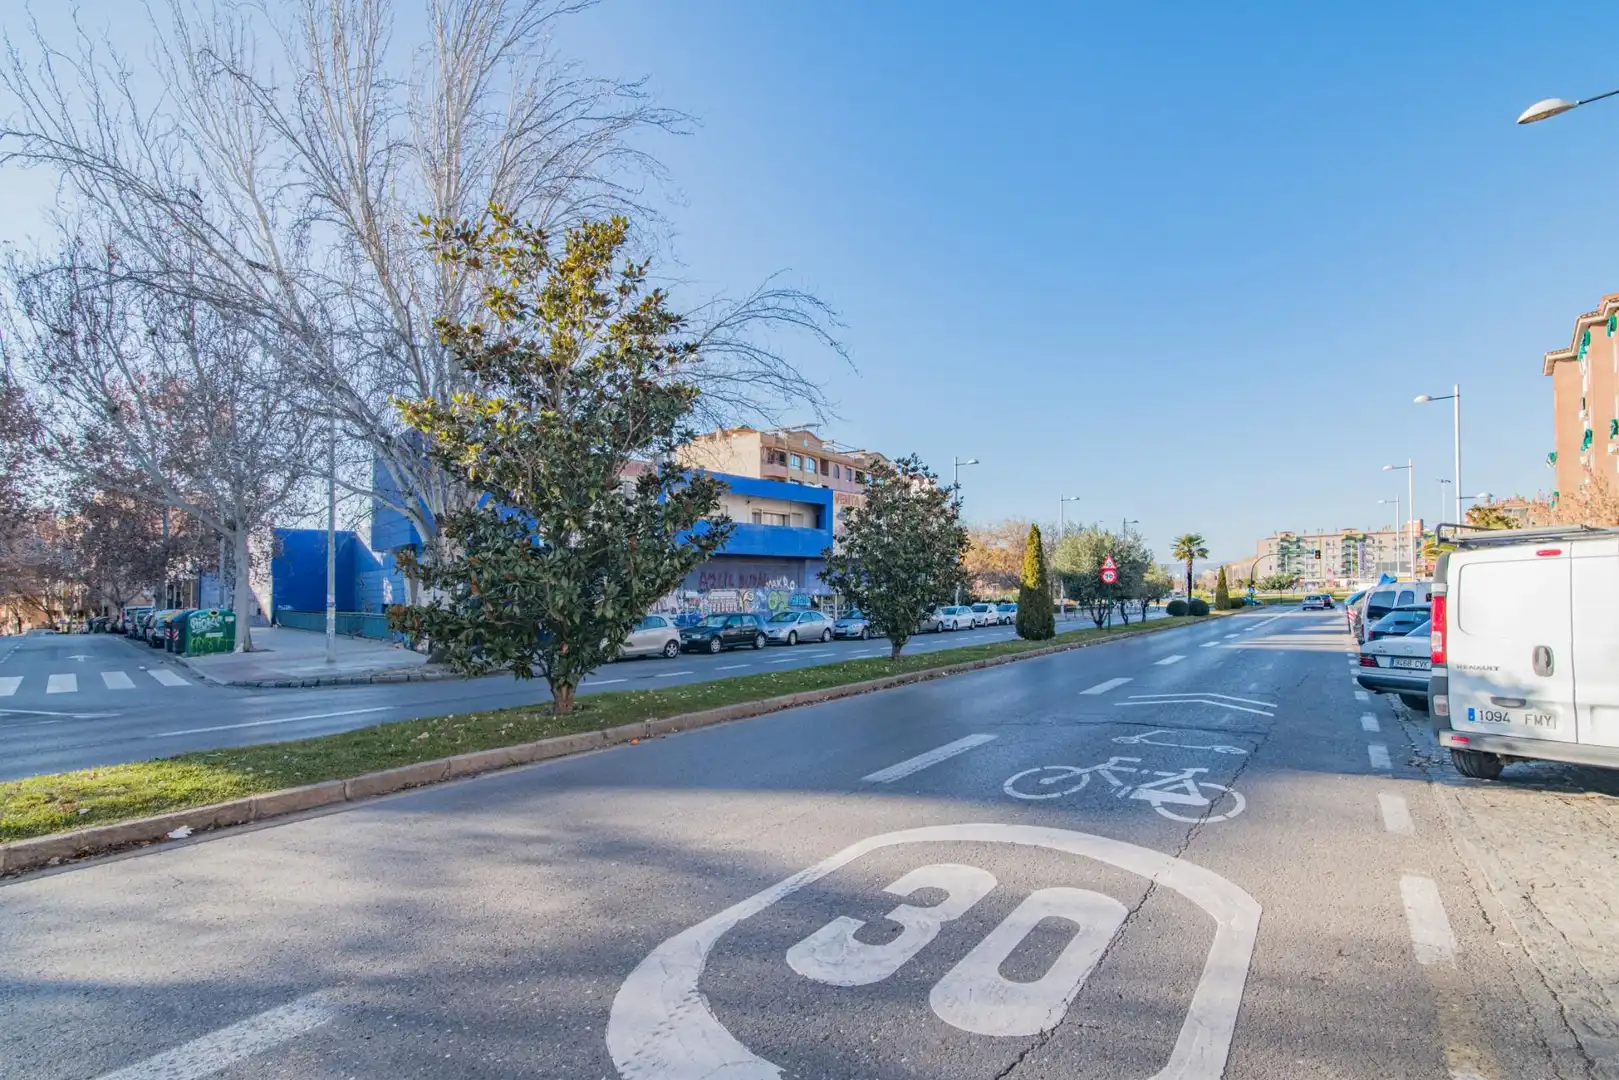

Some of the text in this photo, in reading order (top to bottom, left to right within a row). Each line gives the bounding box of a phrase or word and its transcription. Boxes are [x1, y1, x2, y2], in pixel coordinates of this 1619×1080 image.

[1478, 709, 1554, 726] 1094 FMY
[786, 863, 1129, 1036] 30
